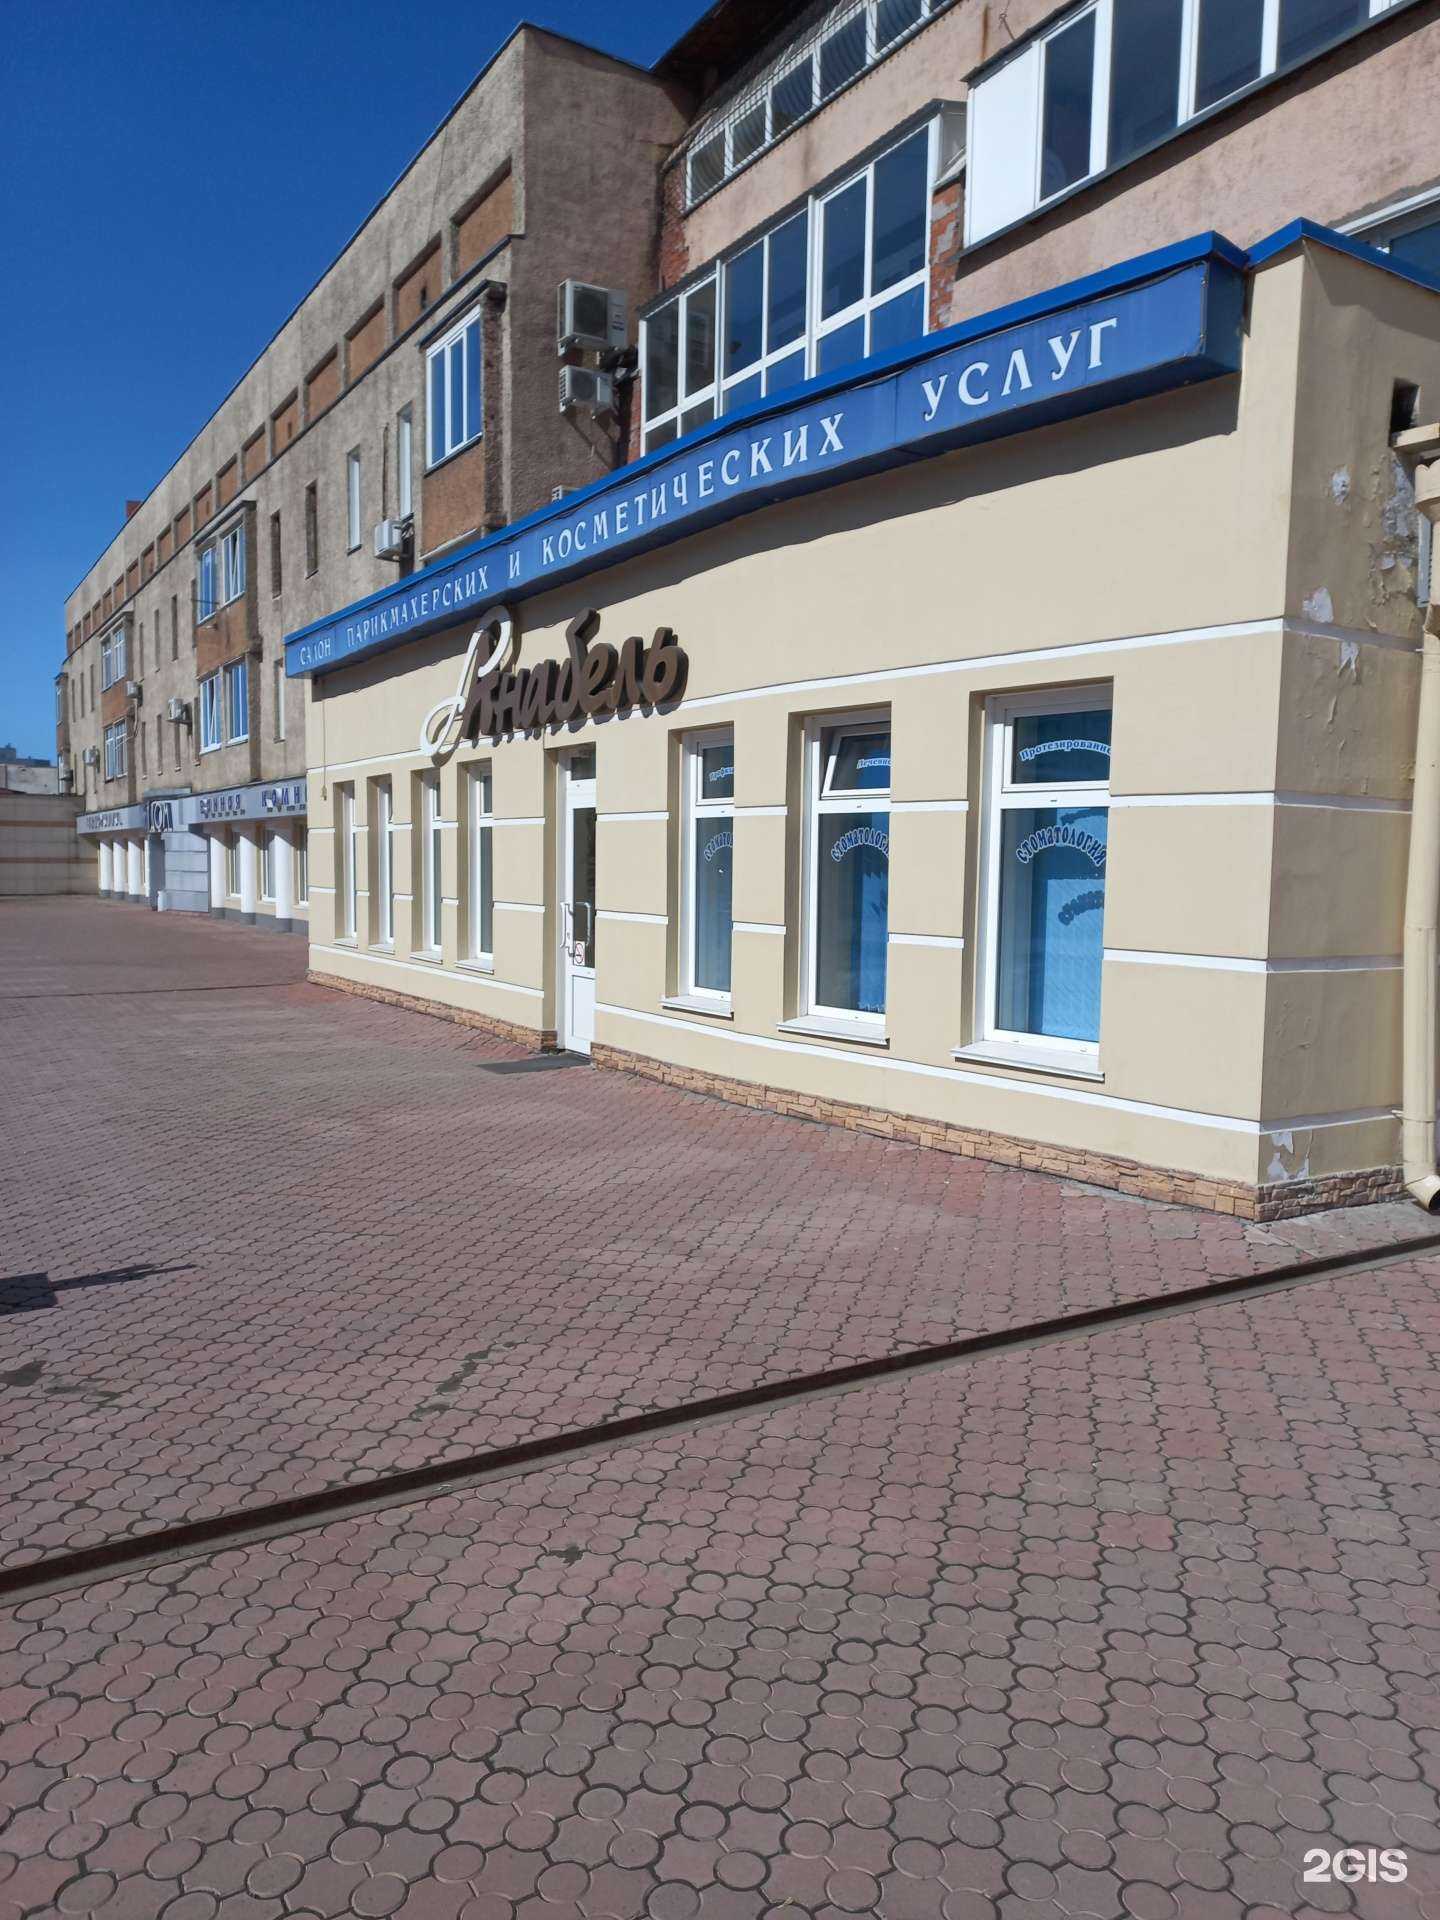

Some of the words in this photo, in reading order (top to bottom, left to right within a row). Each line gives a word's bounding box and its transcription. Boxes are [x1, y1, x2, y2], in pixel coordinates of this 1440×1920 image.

[300, 636, 332, 666] САЛОН
[346, 565, 489, 648] ПАРИКМАХЕРСКИХ
[508, 551, 521, 581] И
[542, 412, 845, 566] КОСМЕТИЧЕСКИХ
[921, 317, 1118, 422] УСЛУГ
